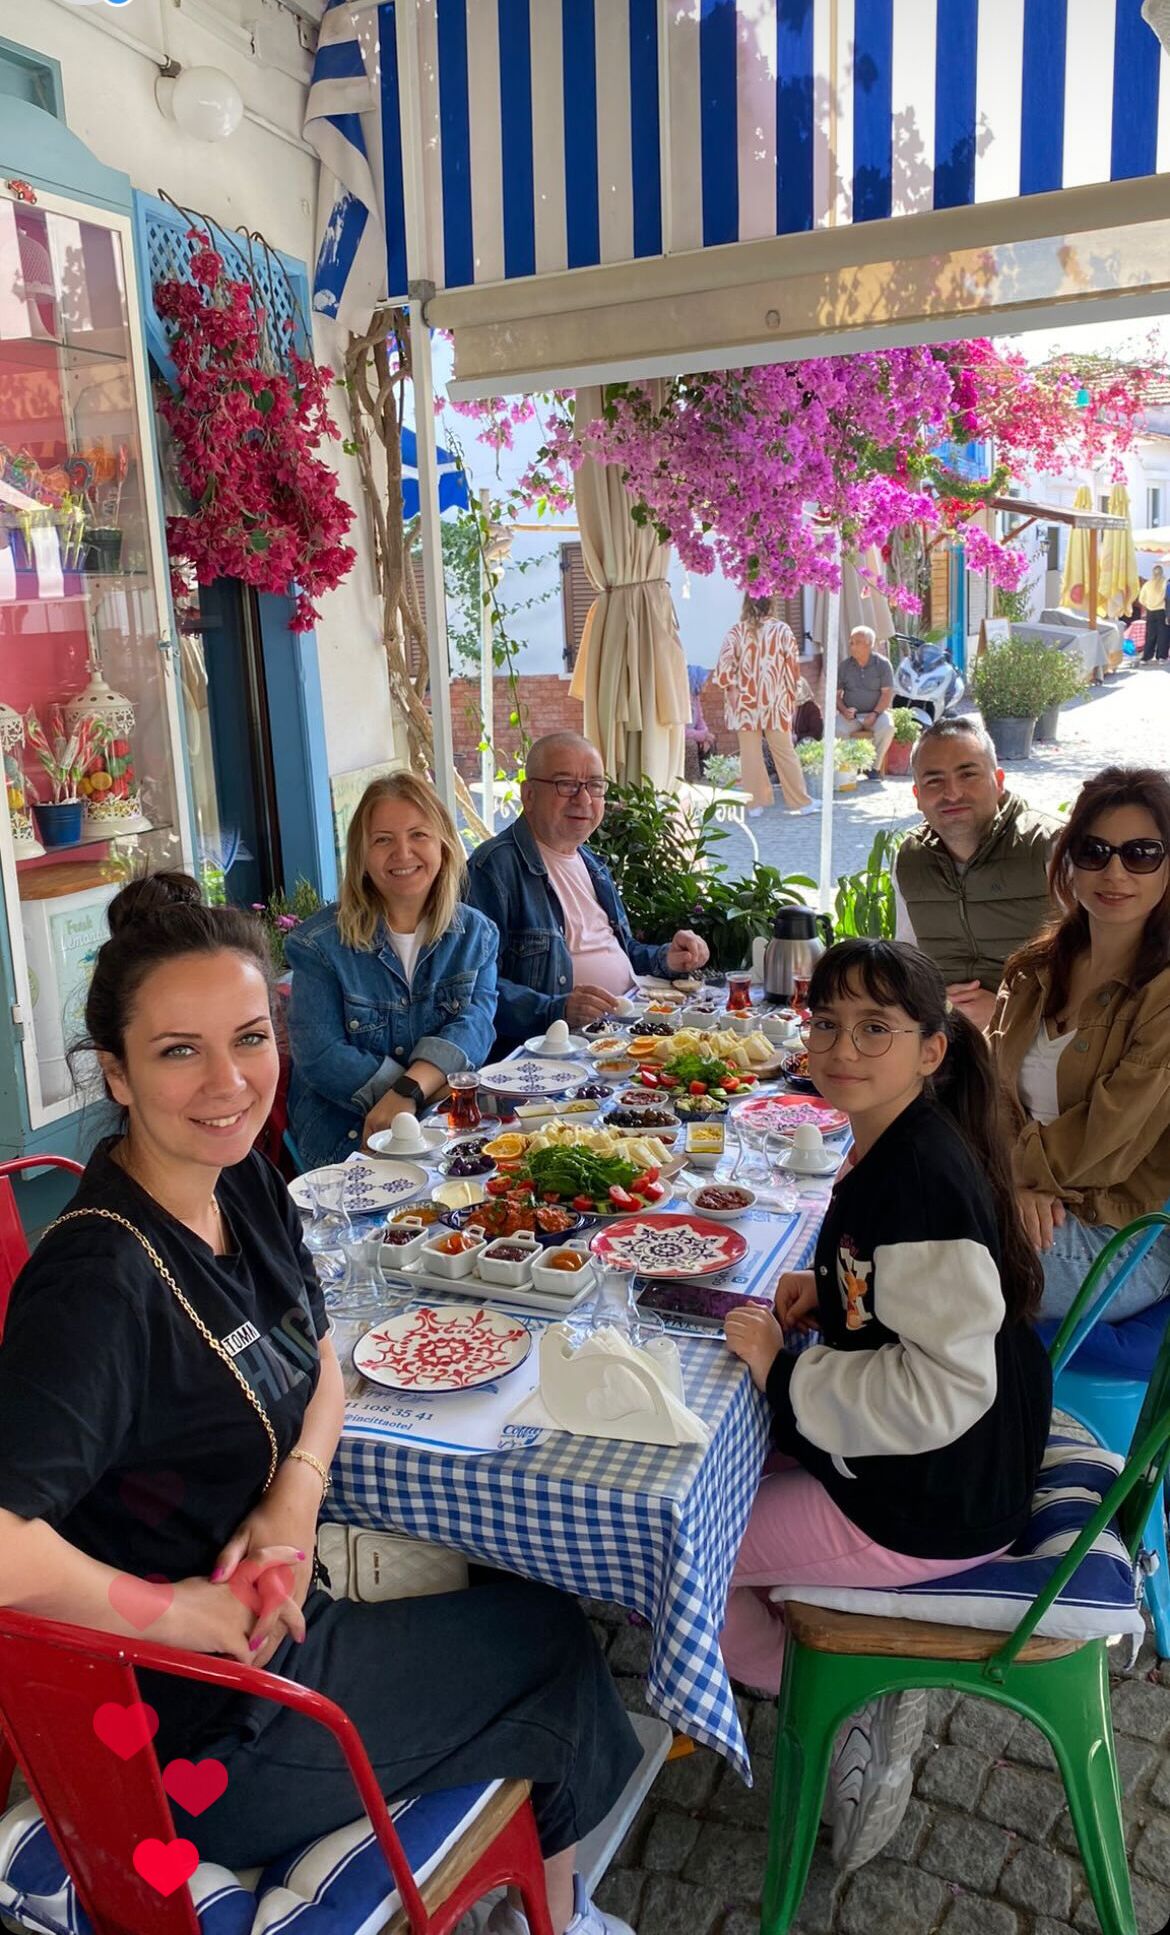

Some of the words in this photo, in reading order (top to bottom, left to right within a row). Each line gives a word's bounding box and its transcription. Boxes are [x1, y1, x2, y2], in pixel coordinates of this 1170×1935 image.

[361, 1403, 392, 1413] 108
[391, 1408, 413, 1419] 35
[415, 1411, 435, 1421] 41
[344, 1412, 414, 1431] @incittaotel
